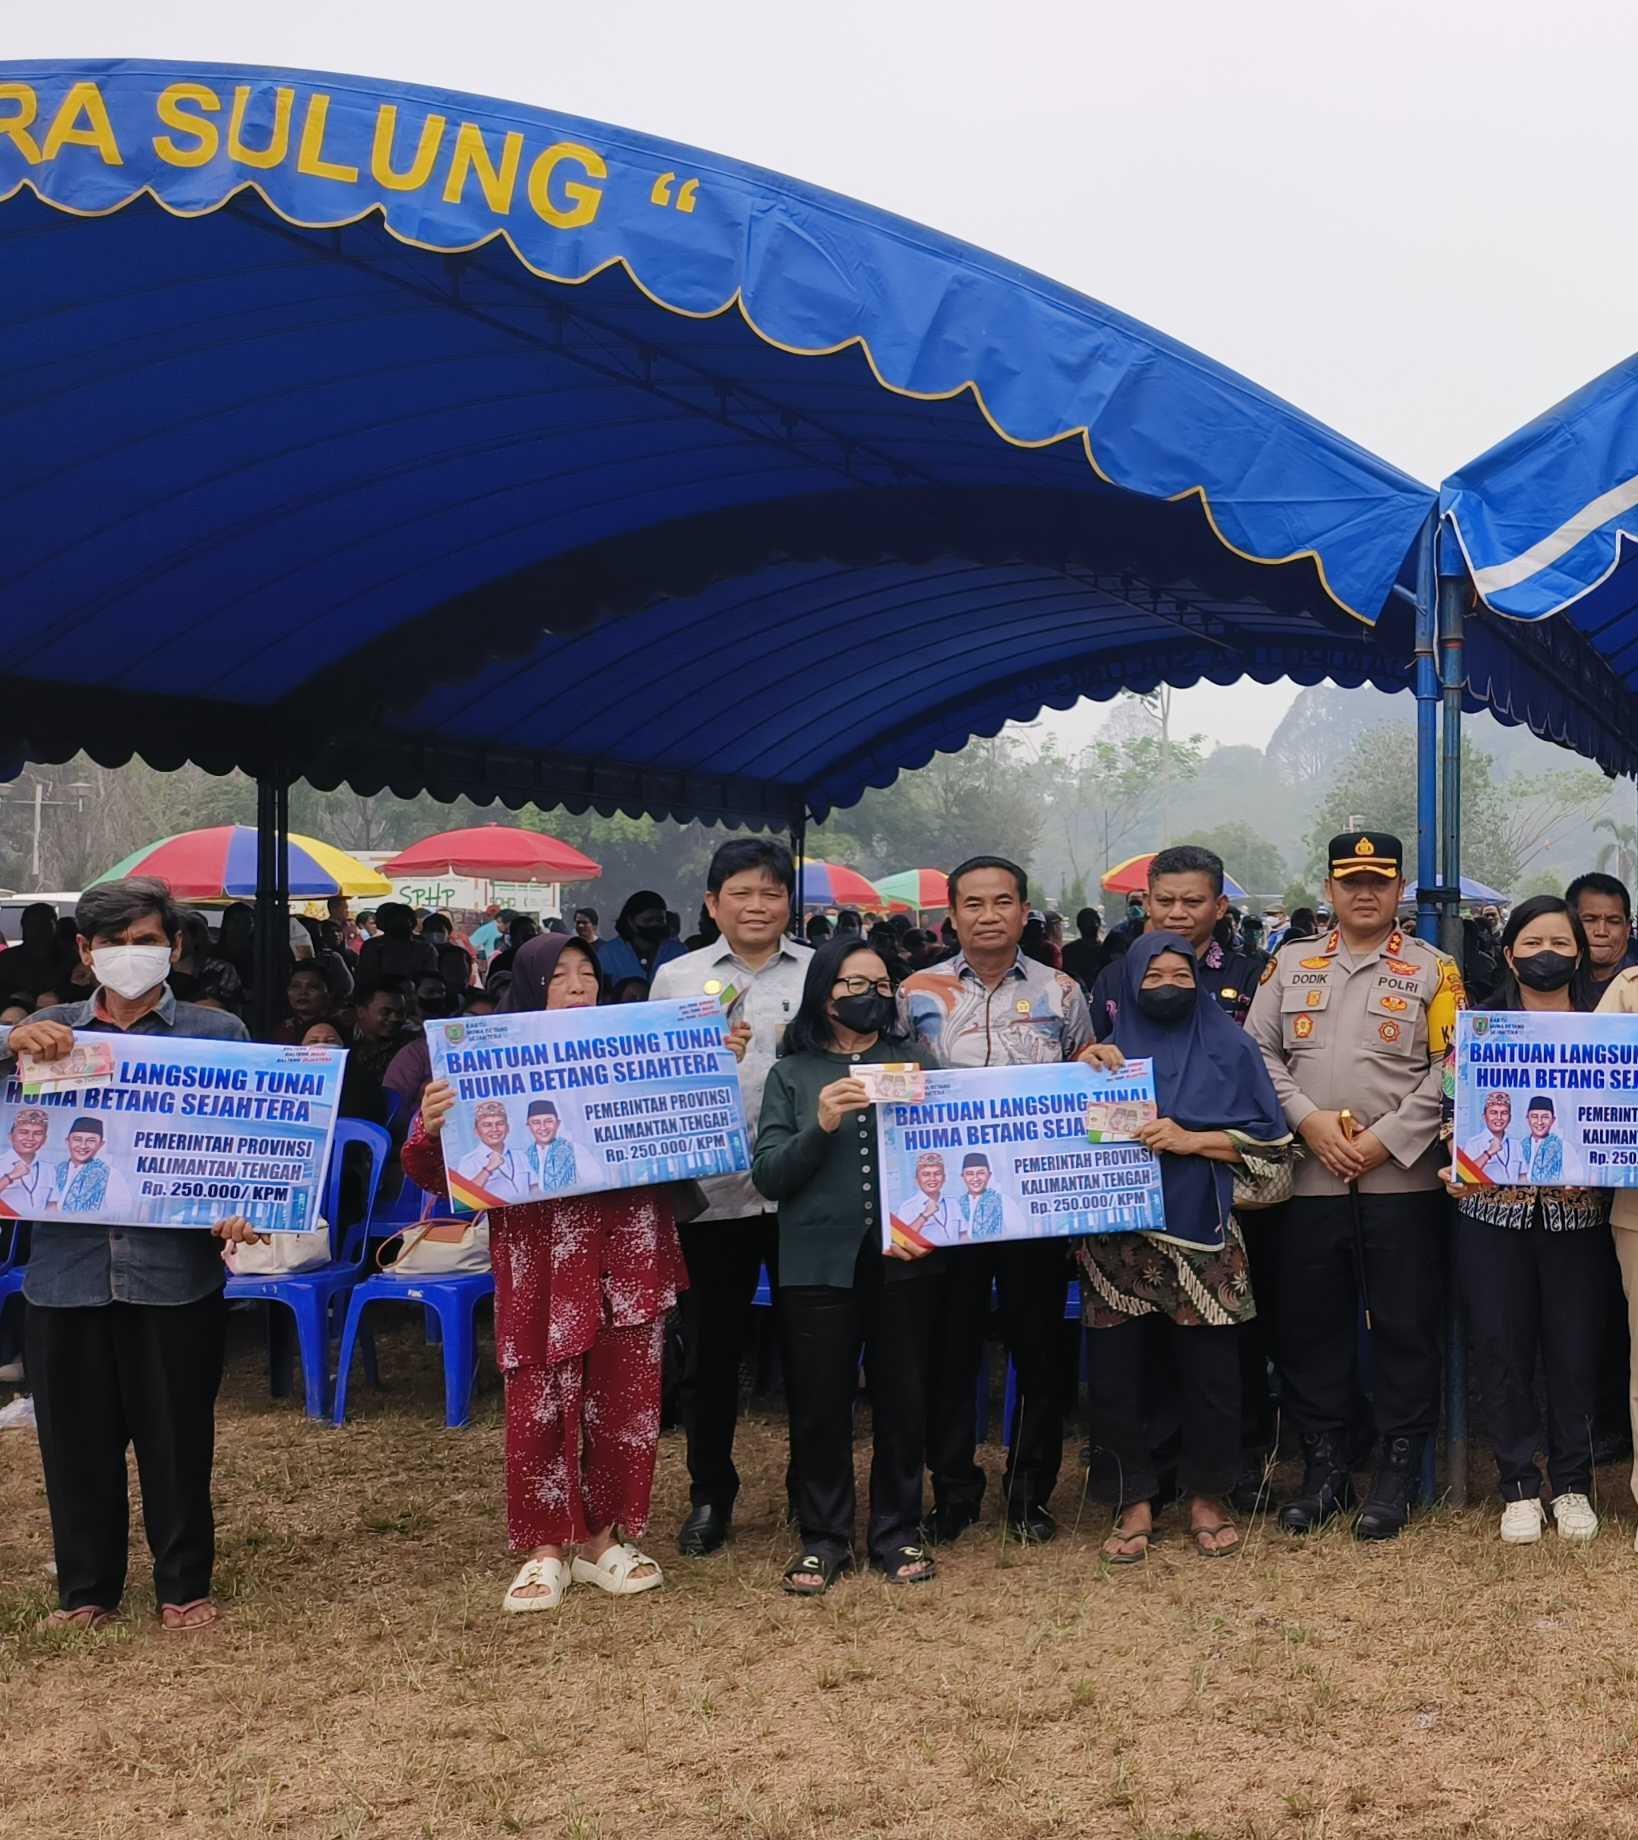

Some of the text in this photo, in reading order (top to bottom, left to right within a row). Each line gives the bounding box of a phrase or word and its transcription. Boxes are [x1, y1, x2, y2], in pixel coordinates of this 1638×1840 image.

[152, 83, 607, 230] SULUNG
[1292, 974, 1328, 985] DODIK
[1378, 977, 1418, 993] POLRI
[447, 1026, 722, 1074] BANTUAN LANGSUNG TUNAI
[1470, 1043, 1555, 1065] BANTUAN
[120, 1062, 324, 1096] LANGSUNG TUNAI
[459, 1052, 719, 1100] HUMA BETANG SEJAHTERA
[1476, 1068, 1533, 1088] HUMA
[1535, 1068, 1604, 1089] BETANG
[84, 1088, 175, 1114] BETANG
[181, 1096, 310, 1121] SEJAHTERA
[585, 1088, 730, 1120] PEMERINTAH PROVINSI
[895, 1100, 985, 1126] BANTUAN
[990, 1092, 1087, 1119] LANGSUNG
[594, 1111, 729, 1143] KALIMANTAN TENGAH
[905, 1127, 962, 1150] HUMA
[967, 1121, 1038, 1145] BETANG
[134, 1131, 312, 1157] PEMERINTAH PROVINSI
[606, 1134, 725, 1162] Rp. 250.000/ KPM
[137, 1157, 302, 1181] KALIMANTAN TENGAH
[1015, 1148, 1154, 1173] PEMERINTAH PROVINSI
[1589, 1152, 1609, 1166] Rp.
[142, 1180, 288, 1202] Rp. 250.000/ KPM
[1021, 1171, 1150, 1196] KALIMANTAN TENGAH
[1030, 1191, 1146, 1215] Rp. 250.000/ KPM
